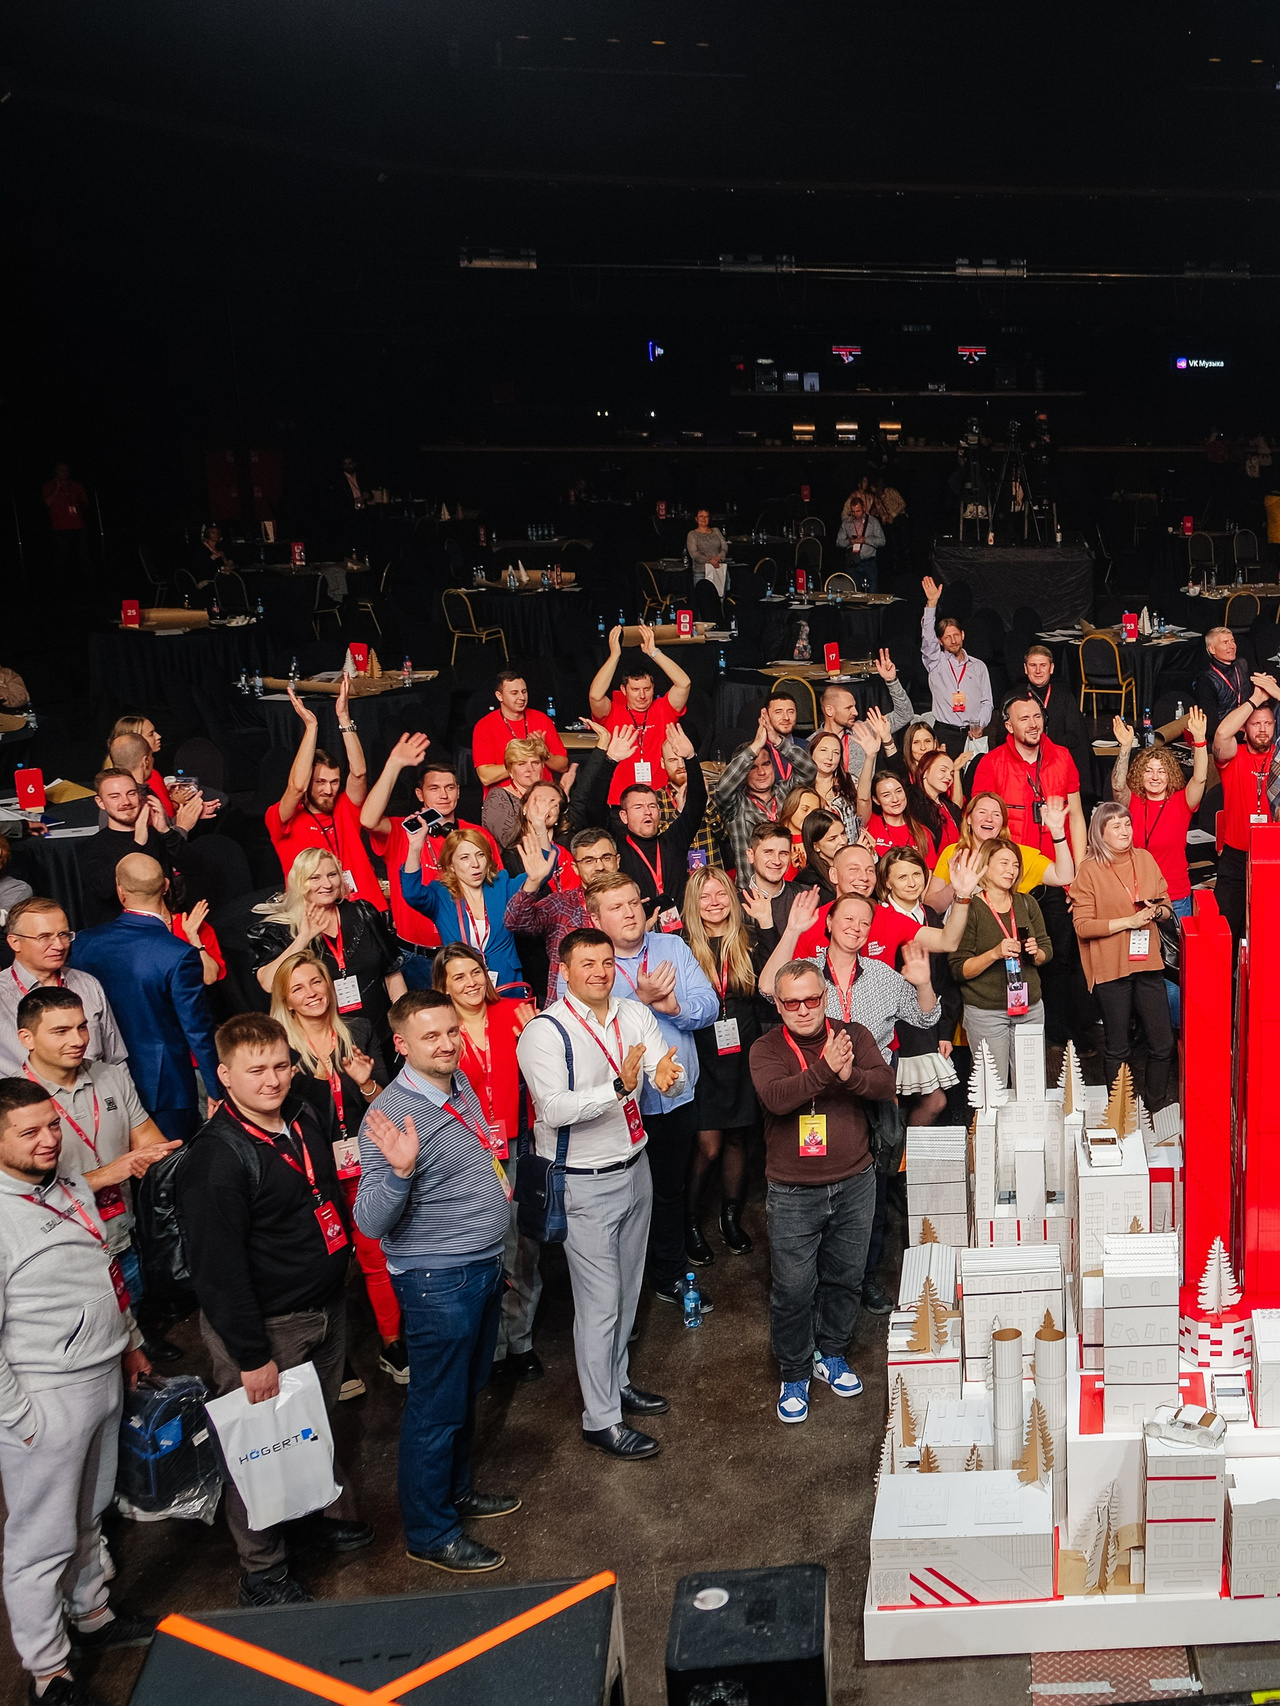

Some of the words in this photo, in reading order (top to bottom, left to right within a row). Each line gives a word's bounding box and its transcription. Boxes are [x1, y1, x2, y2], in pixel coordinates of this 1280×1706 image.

[1188, 359, 1198, 367] VK
[1199, 359, 1224, 368] Музыка
[27, 784, 35, 794] 6
